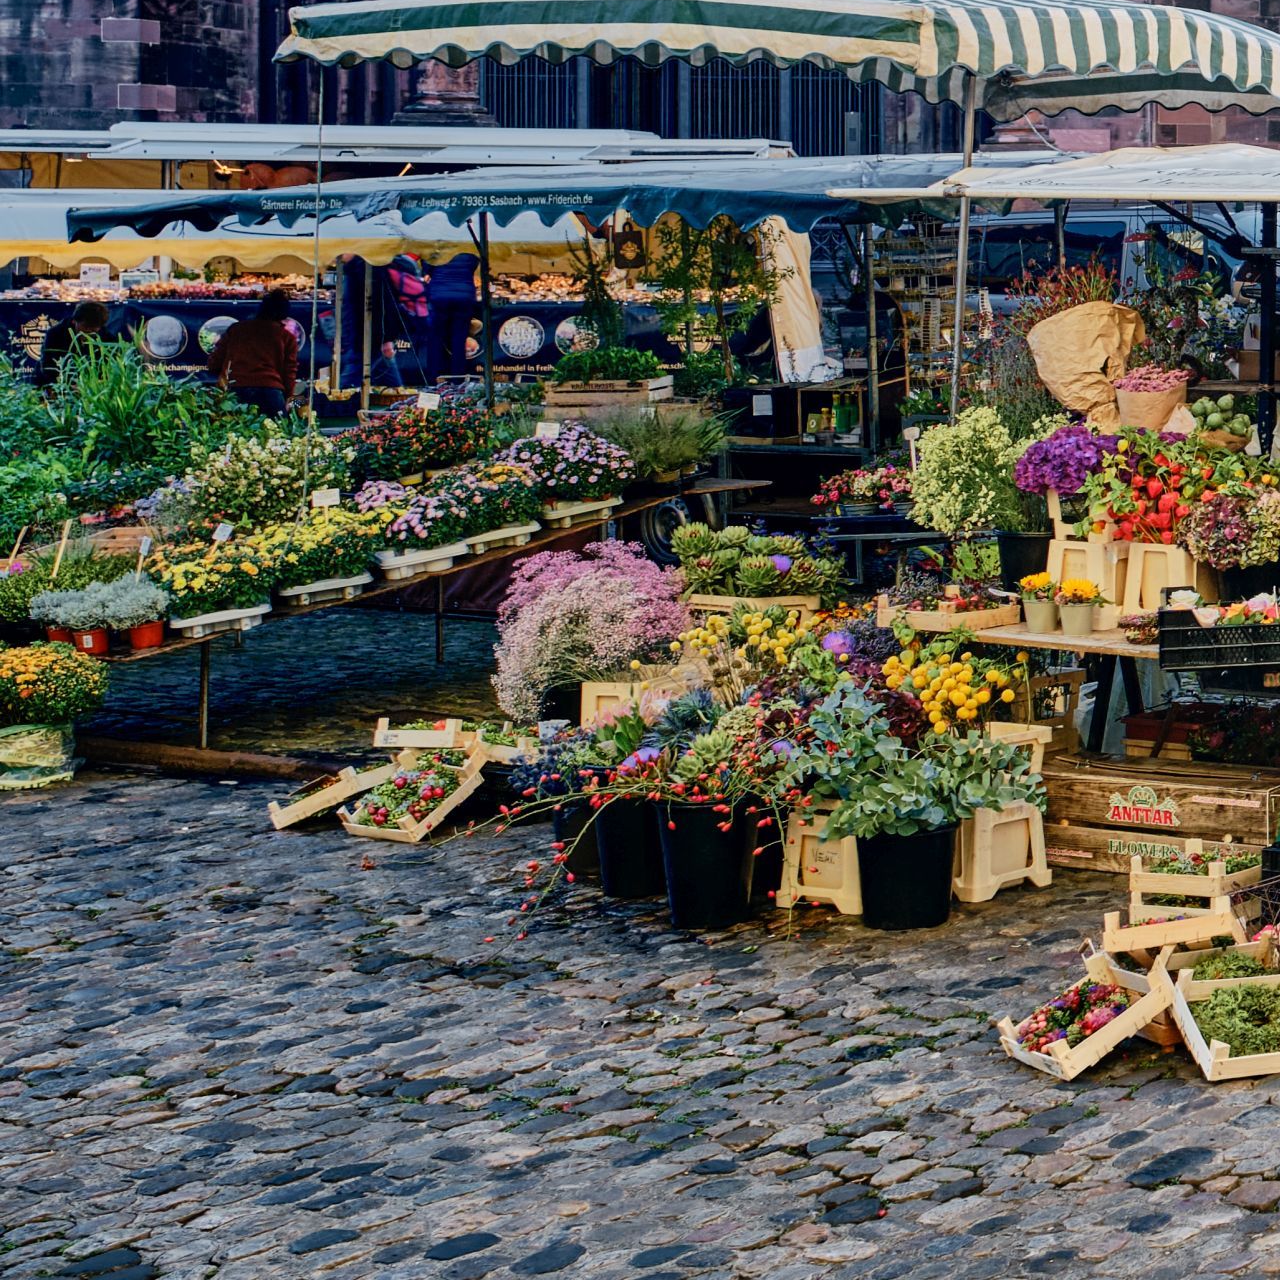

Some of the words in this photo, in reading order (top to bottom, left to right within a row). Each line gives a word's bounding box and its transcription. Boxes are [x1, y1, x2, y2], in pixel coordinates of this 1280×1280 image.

[261, 200, 295, 210] Gärtnerei
[452, 197, 457, 207] 2
[462, 196, 488, 206] 79361
[490, 195, 518, 206] Sasbach
[527, 194, 593, 205] www.Friderich.de
[1110, 805, 1175, 826] ANTTAR
[1108, 839, 1181, 858] FLOWERS
